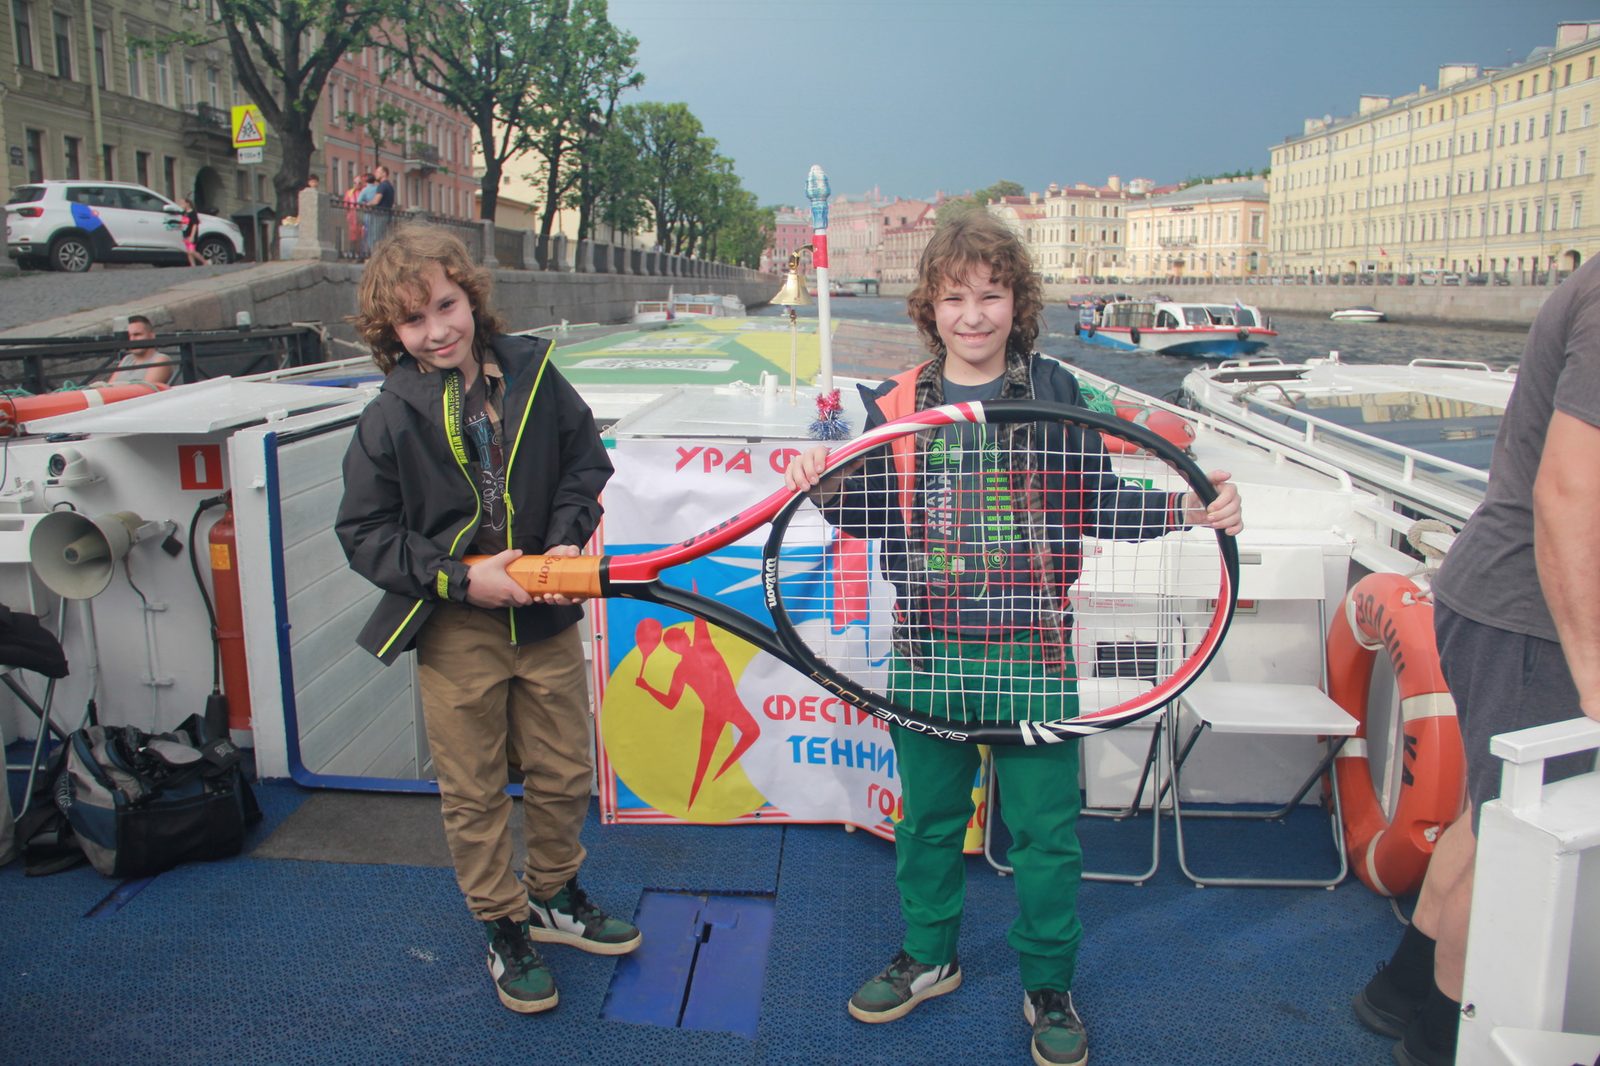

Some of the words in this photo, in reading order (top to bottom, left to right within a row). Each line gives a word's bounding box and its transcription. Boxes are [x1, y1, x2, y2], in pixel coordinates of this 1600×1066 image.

[675, 446, 752, 475] УРА
[763, 555, 777, 610] Wilson
[810, 671, 870, 708] TOUR
[763, 694, 890, 732] ФЕСТИ
[872, 707, 969, 742] SIX.ONE
[787, 737, 898, 779] ТЕННИ
